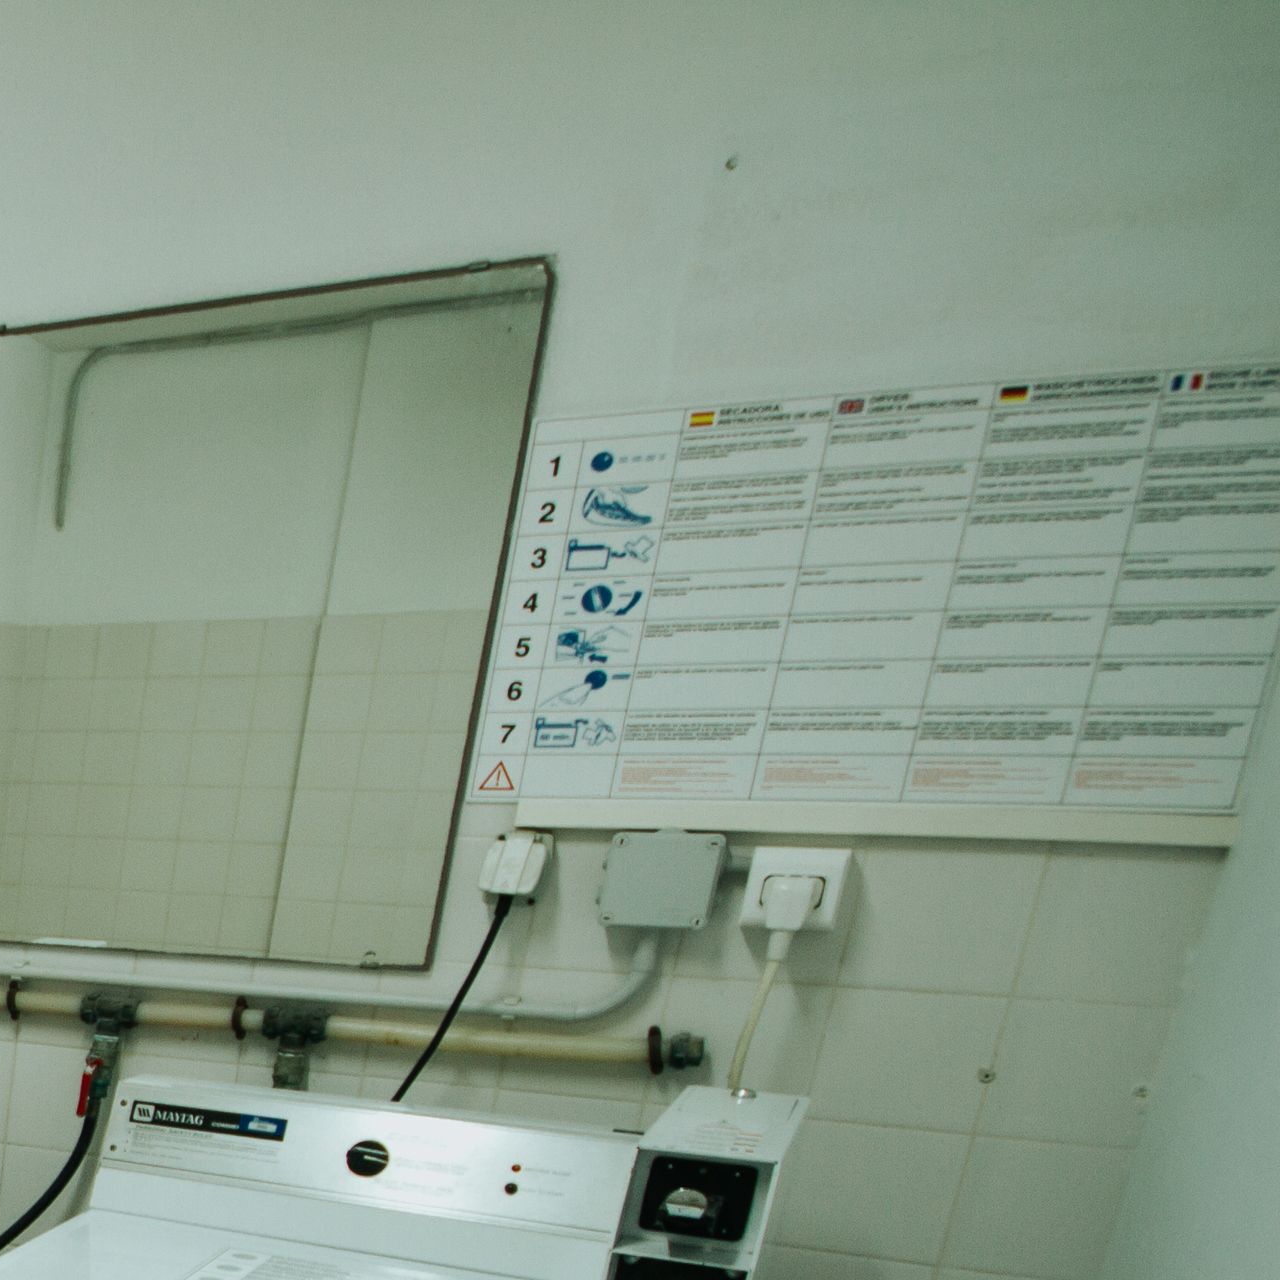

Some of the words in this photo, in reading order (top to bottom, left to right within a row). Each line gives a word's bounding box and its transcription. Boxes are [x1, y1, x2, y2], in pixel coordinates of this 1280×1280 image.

[550, 456, 561, 477] 1
[538, 504, 556, 523] 2
[530, 548, 547, 568] 3
[522, 594, 538, 612] 4
[515, 638, 531, 658] 5
[507, 682, 522, 702] 6
[501, 725, 516, 744] 7
[154, 1110, 204, 1126] MAYTAG
